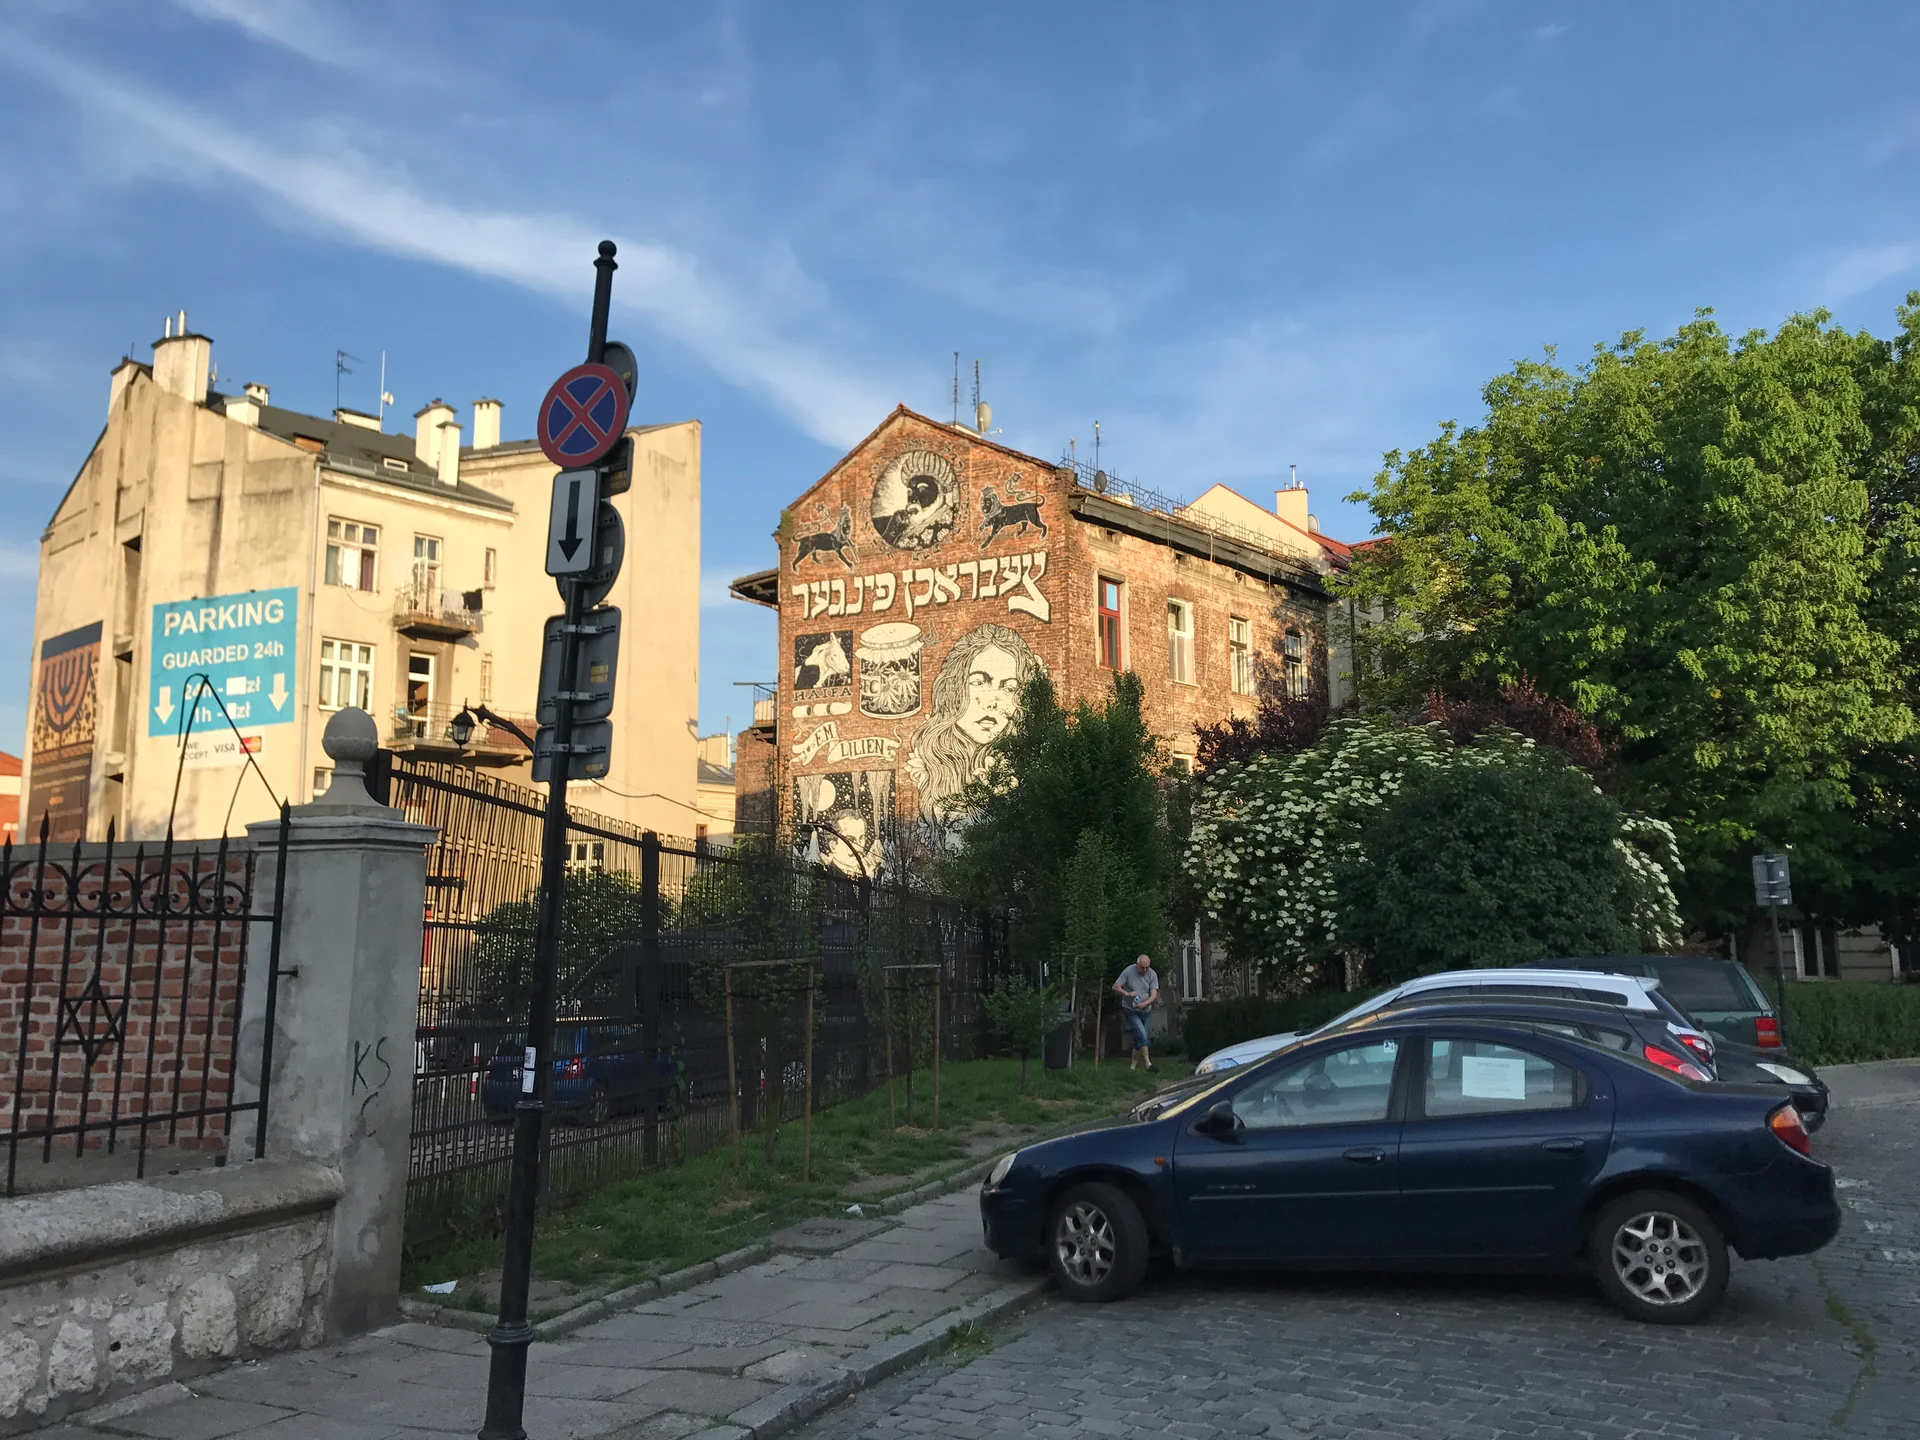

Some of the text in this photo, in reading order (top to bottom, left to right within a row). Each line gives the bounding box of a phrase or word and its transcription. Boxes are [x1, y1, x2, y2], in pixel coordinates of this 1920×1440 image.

[163, 598, 285, 637] PARKING
[162, 641, 284, 670] GUARDED 24h
[793, 686, 853, 702] HAIFA
[214, 743, 236, 753] VISA
[840, 738, 885, 758] LILIEN
[351, 1036, 391, 1096] KS
